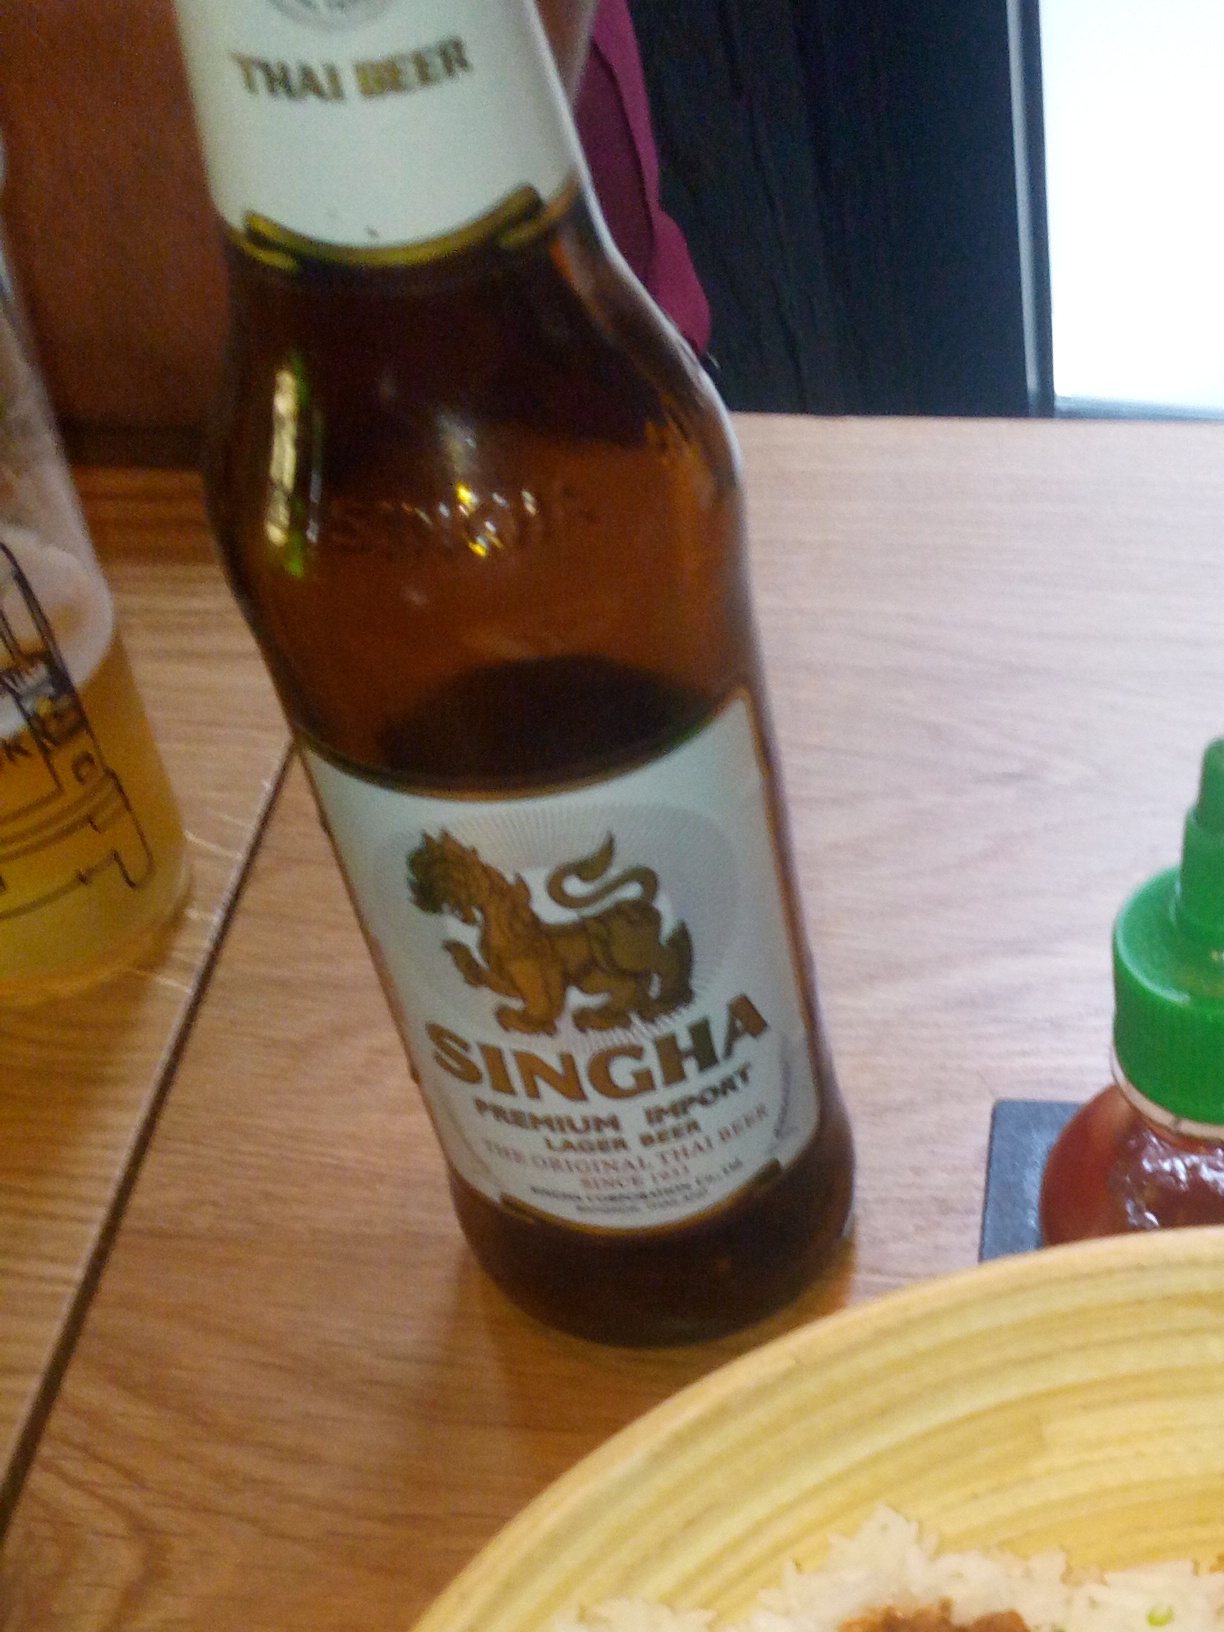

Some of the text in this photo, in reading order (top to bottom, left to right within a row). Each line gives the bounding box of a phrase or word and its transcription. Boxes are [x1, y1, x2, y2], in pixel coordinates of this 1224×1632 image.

[230, 35, 472, 101] THAI BEER
[426, 993, 769, 1102] SINGHA
[474, 1062, 752, 1134] PREMIUM IMPORT
[543, 1119, 701, 1152] LAGER BEER
